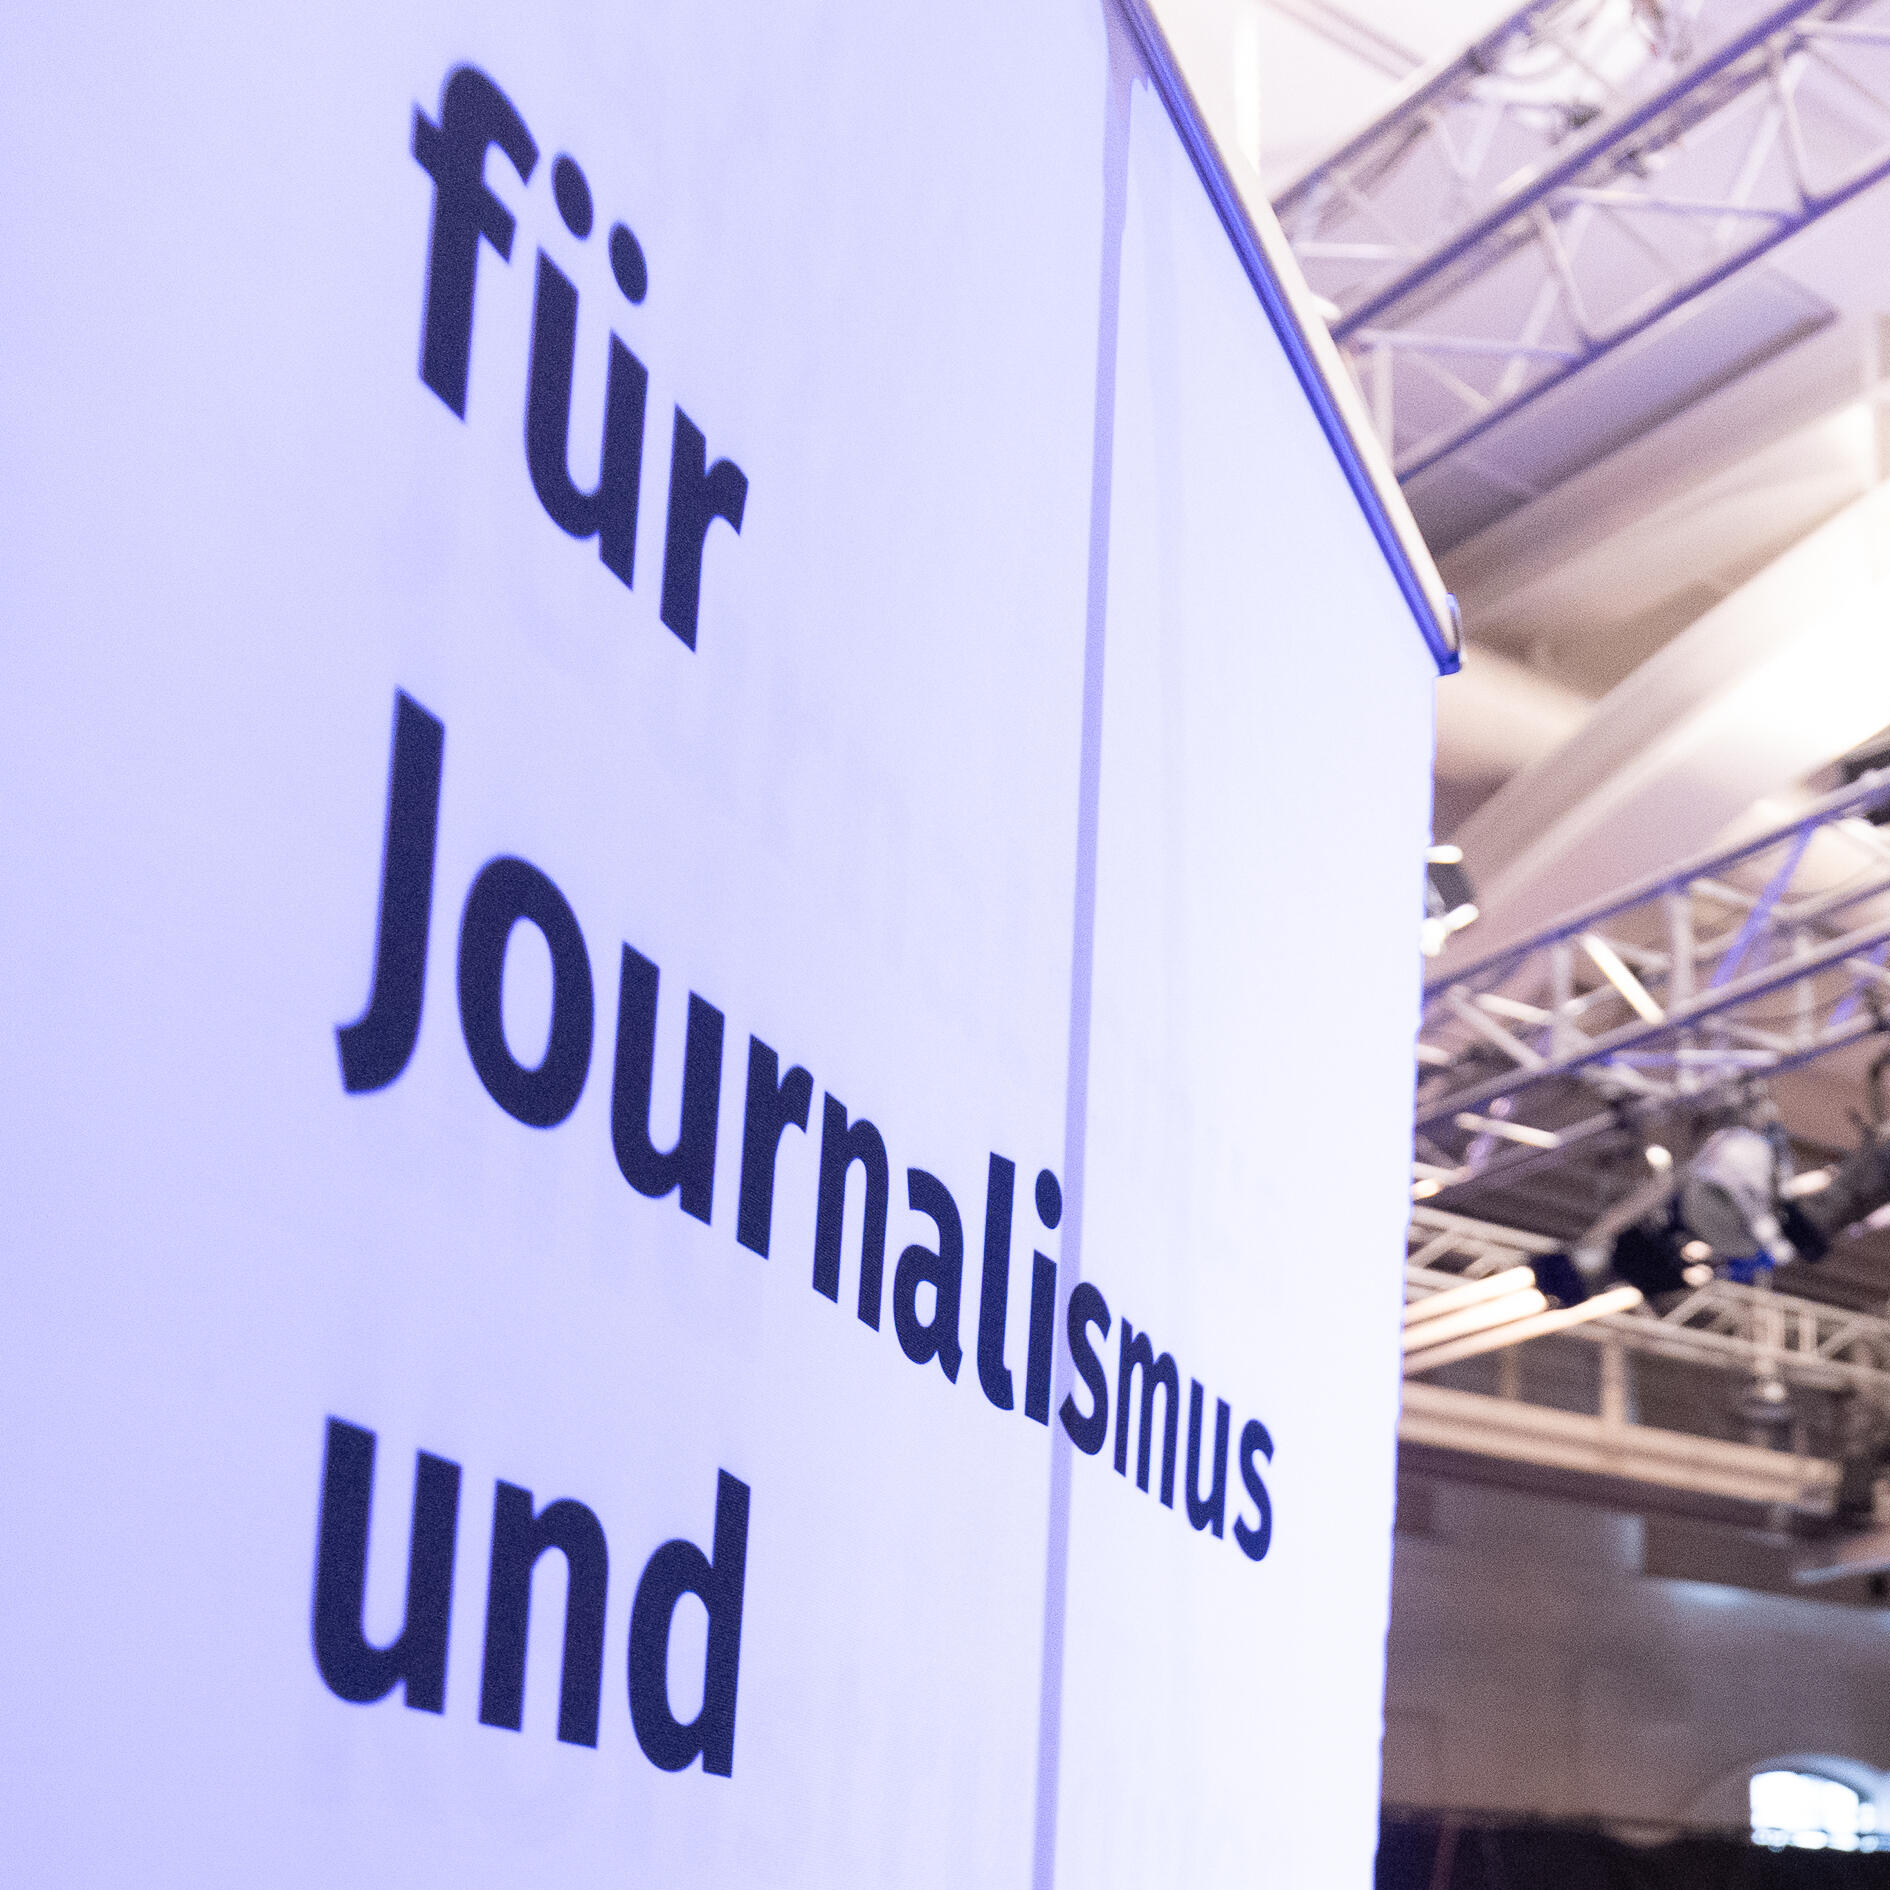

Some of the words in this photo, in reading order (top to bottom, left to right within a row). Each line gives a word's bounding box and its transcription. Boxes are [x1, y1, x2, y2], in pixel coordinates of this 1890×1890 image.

[412, 62, 750, 653] für
[335, 688, 1276, 1563] Journalismus
[310, 1414, 752, 1779] und
